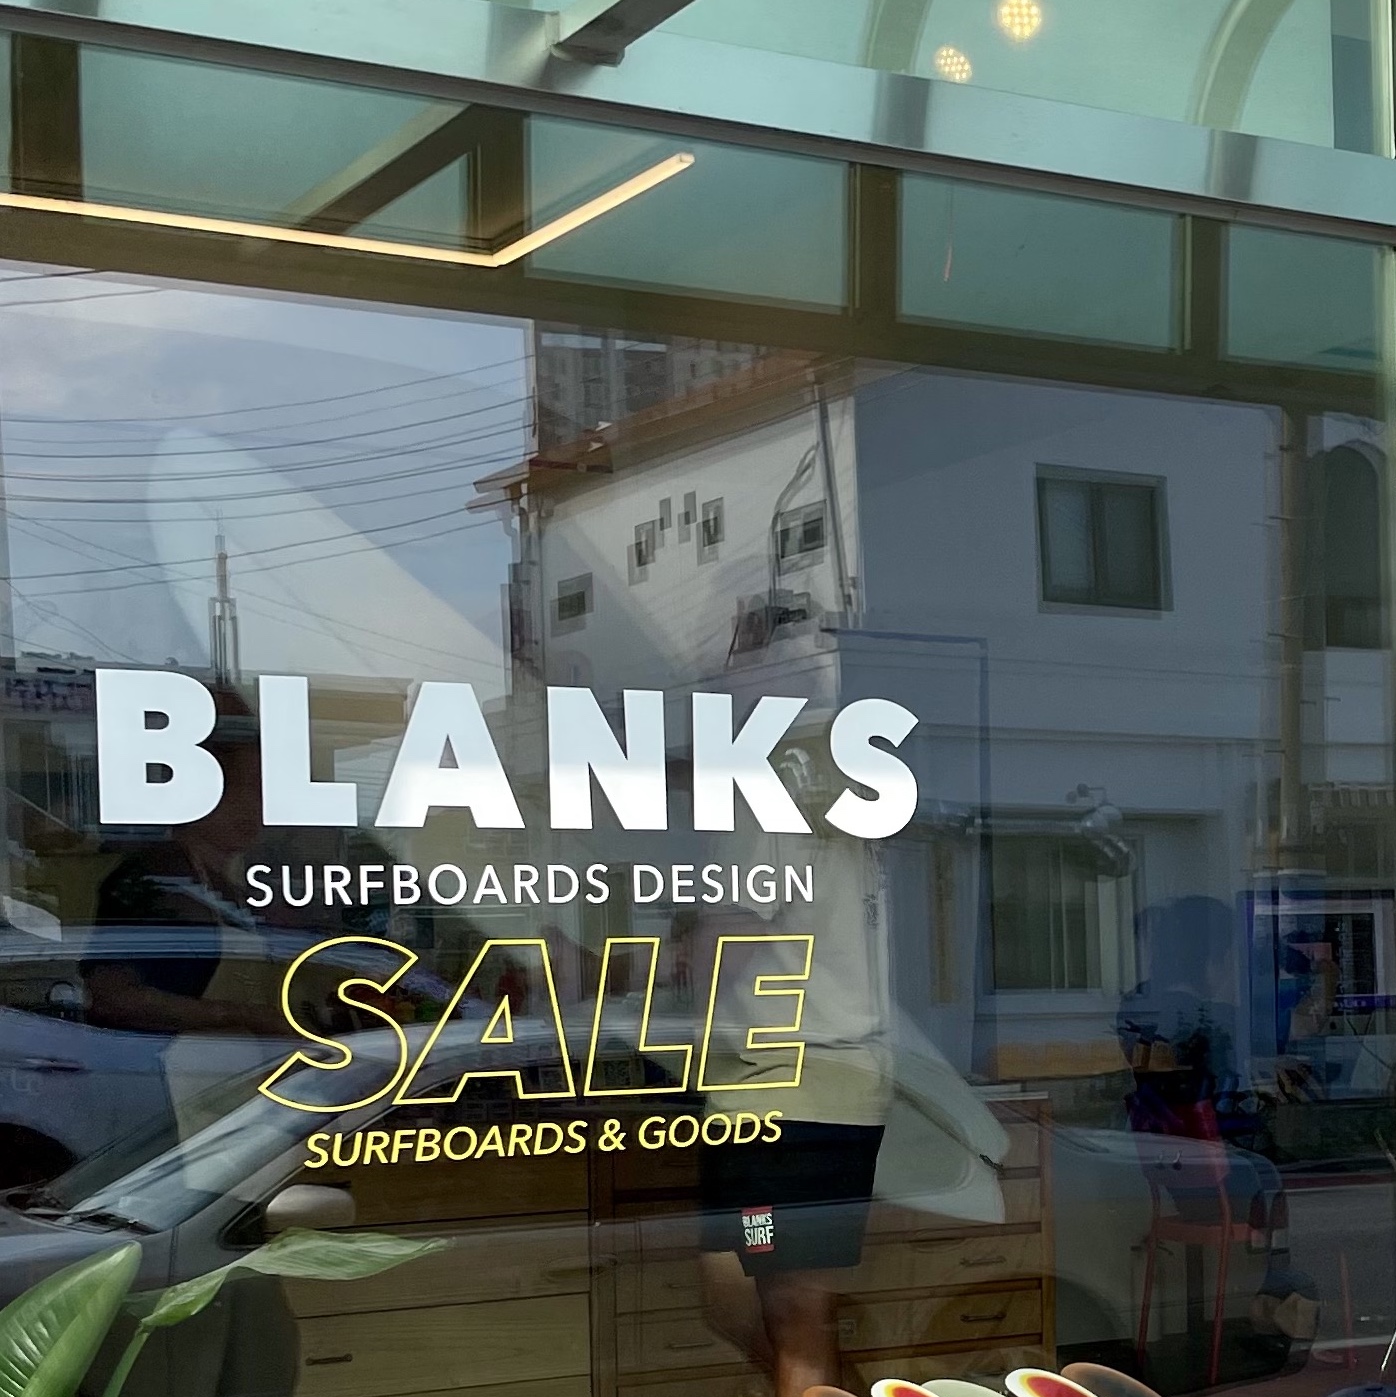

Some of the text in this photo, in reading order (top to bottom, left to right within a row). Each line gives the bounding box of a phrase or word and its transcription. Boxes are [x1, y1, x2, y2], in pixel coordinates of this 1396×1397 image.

[93, 667, 919, 840] BLANKS
[245, 862, 815, 909] SURFBOARDS DESIGN
[257, 933, 815, 1114] SALE
[303, 1109, 784, 1170] SURFBOARDS & GOODS
[742, 1212, 773, 1228] BLANKS
[744, 1225, 775, 1247] SURF
